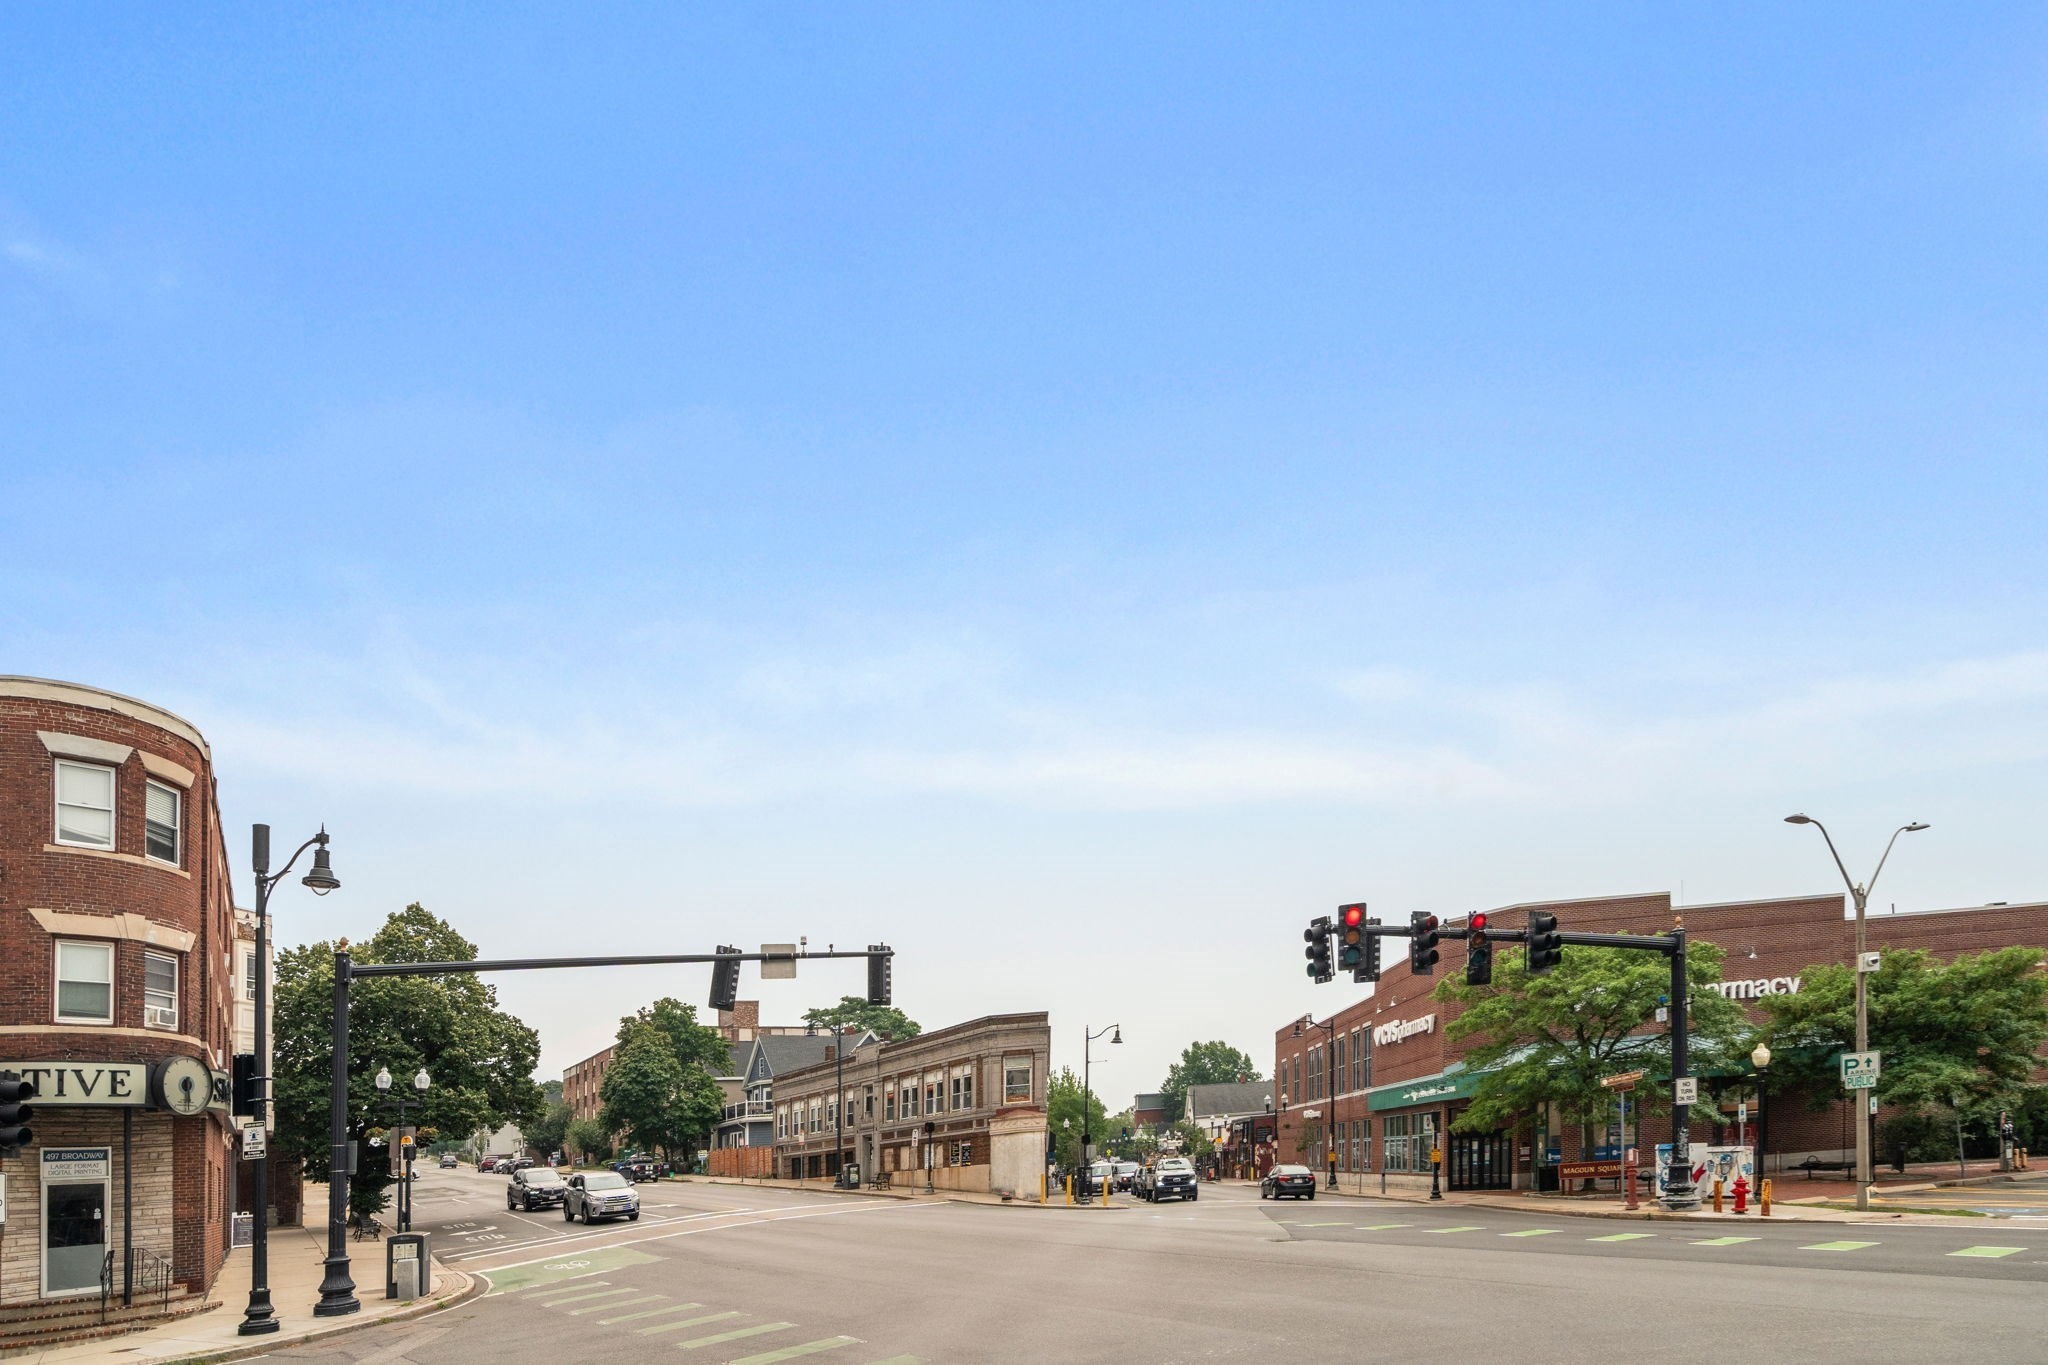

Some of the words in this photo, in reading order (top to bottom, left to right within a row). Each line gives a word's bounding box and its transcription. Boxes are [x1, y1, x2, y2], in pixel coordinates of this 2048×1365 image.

[20, 1068, 131, 1097] TIVE
[1847, 1076, 1873, 1087] PUBLIC
[61, 1152, 105, 1160] BROADWAY
[1563, 1166, 1595, 1174] MAGOUN
